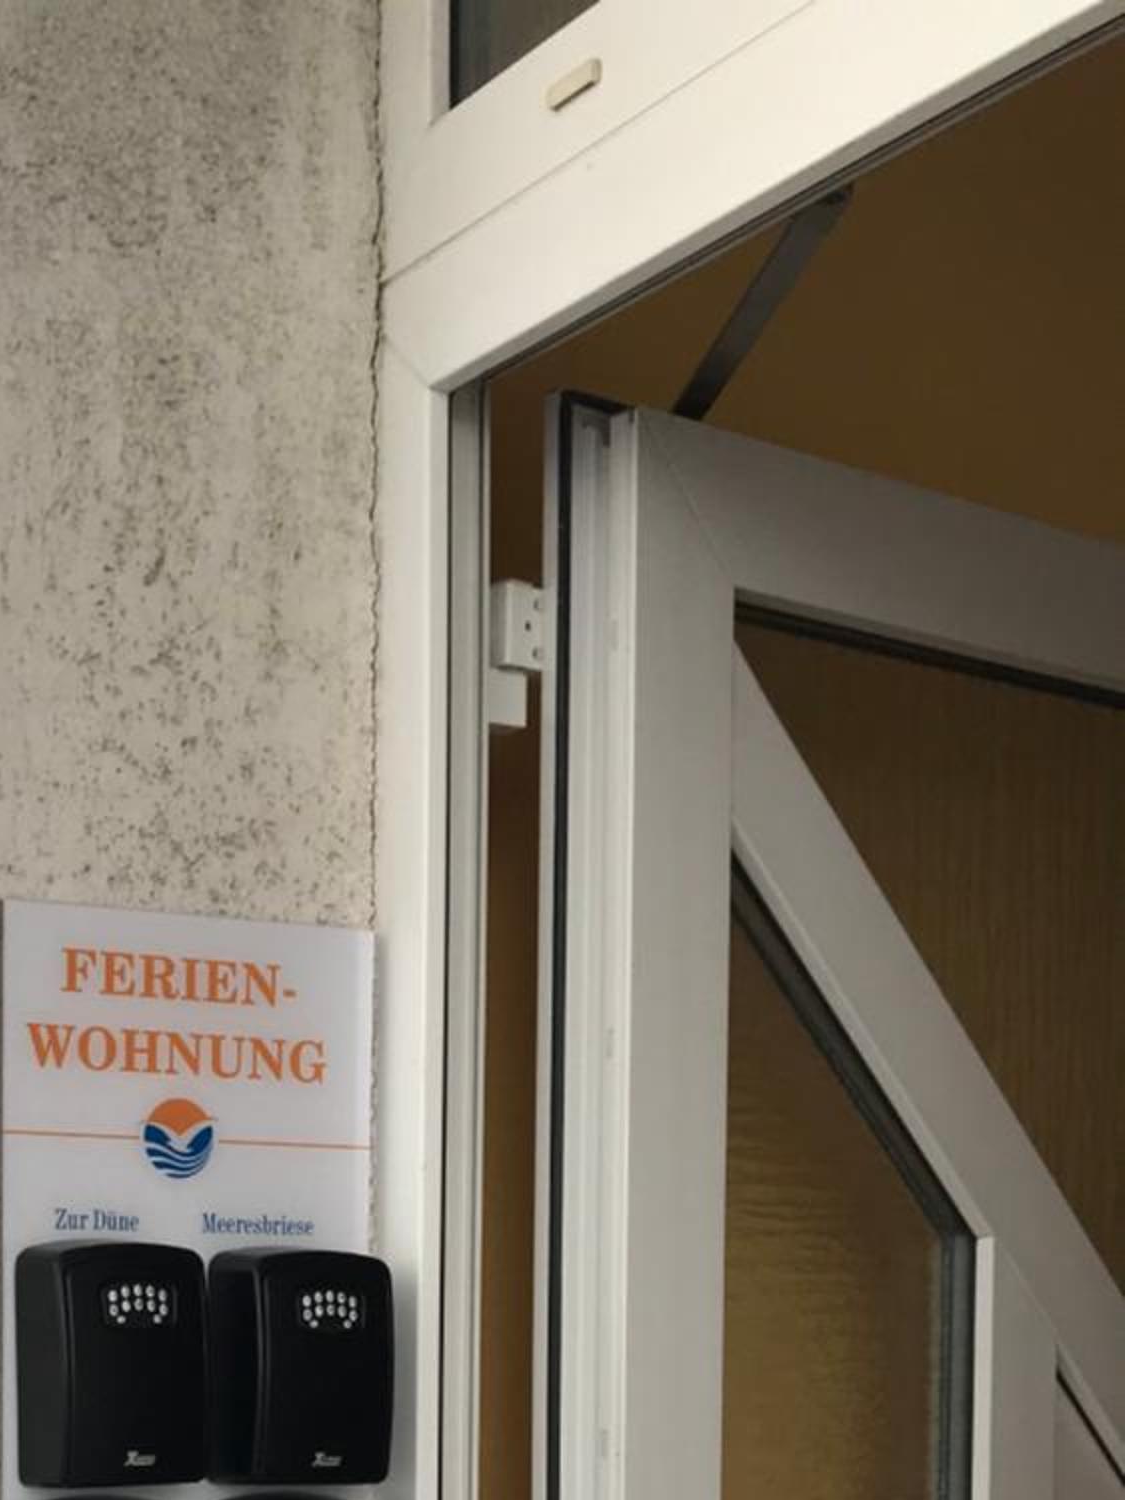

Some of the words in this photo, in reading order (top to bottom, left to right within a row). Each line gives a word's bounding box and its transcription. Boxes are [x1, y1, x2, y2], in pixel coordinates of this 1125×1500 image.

[61, 946, 297, 1008] FERIEN-
[27, 1022, 328, 1085] WOHNUNG
[54, 1208, 89, 1231] Zur
[93, 1208, 140, 1233] Düne
[202, 1212, 315, 1236] Meeresbriese
